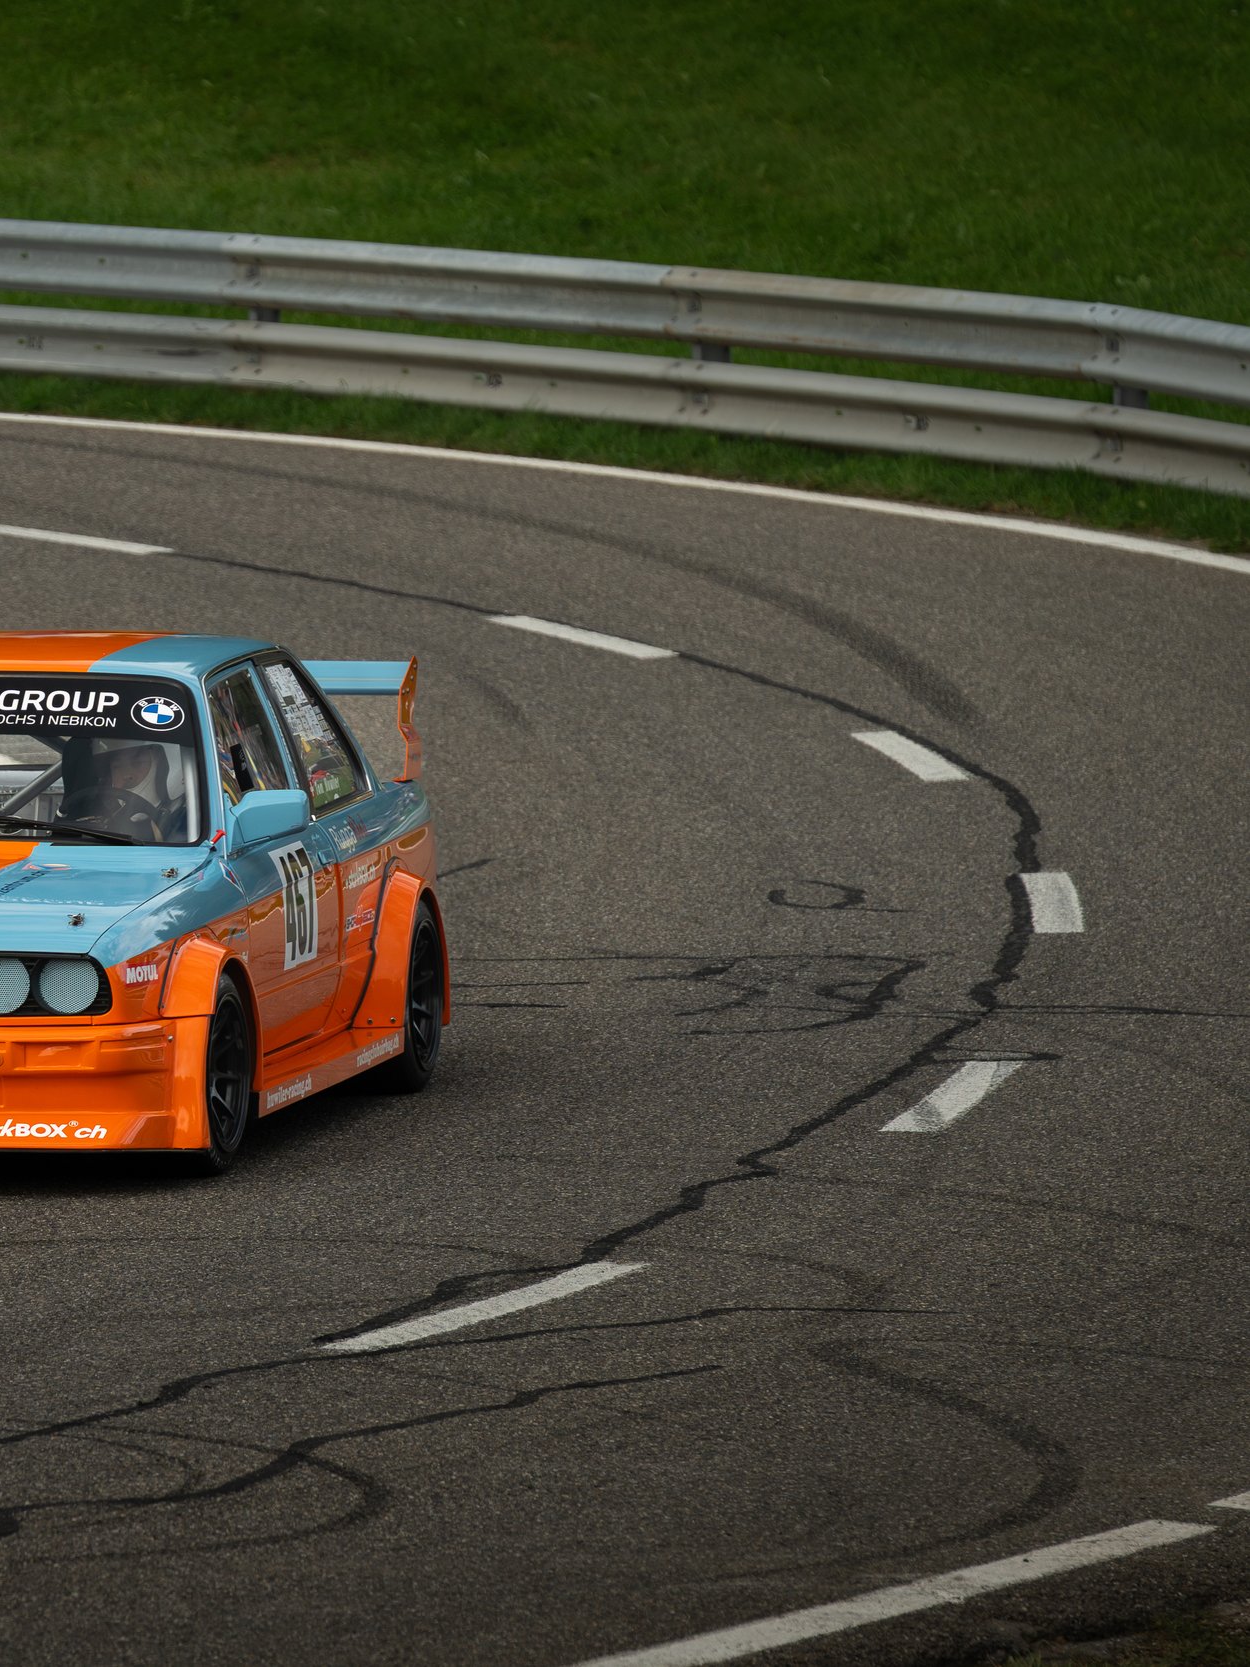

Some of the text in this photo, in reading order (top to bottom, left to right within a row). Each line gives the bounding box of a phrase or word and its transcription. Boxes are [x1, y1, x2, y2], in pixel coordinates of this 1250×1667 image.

[48, 715, 117, 728] NEBIKON
[279, 847, 313, 960] 467
[126, 964, 158, 984] MOTUL
